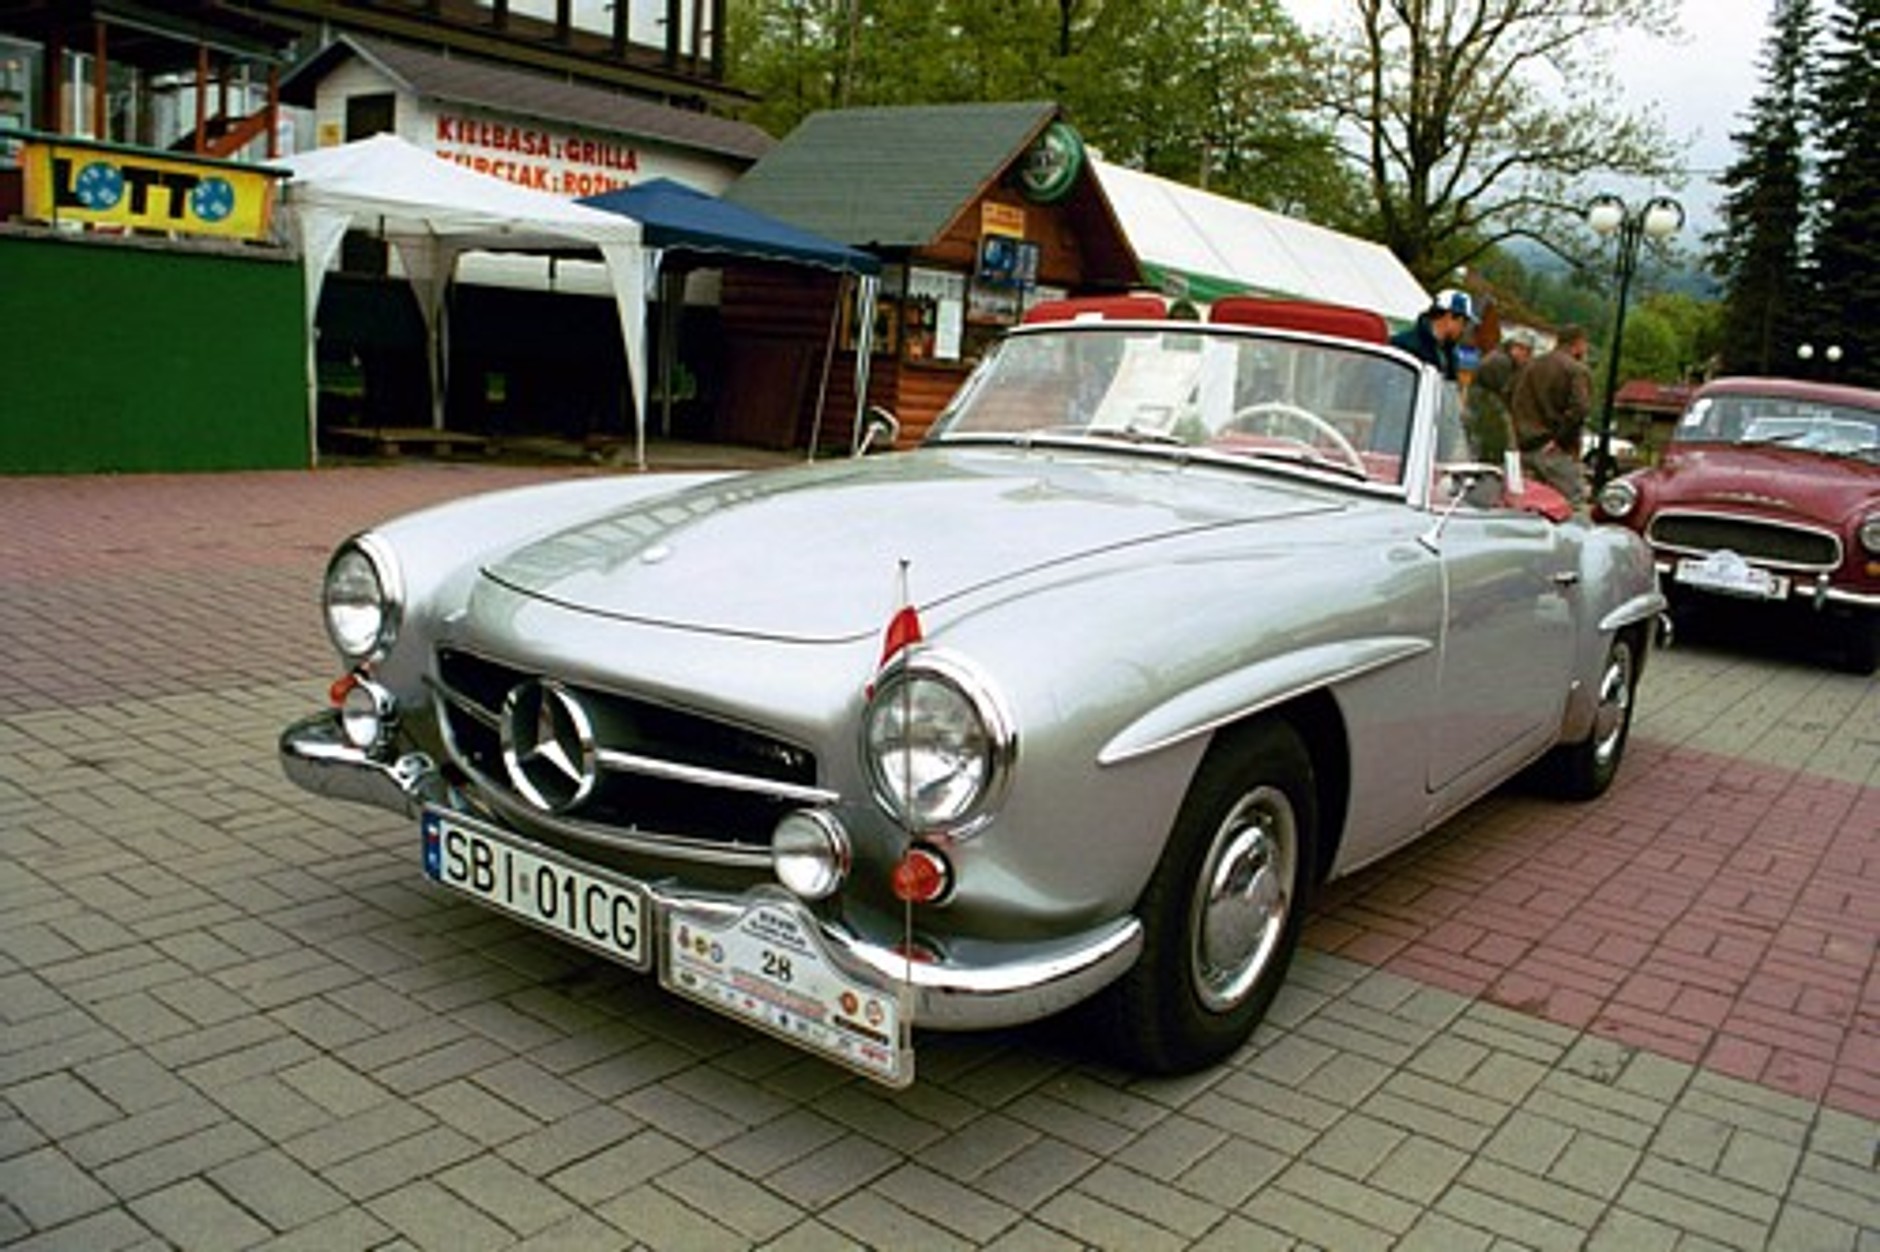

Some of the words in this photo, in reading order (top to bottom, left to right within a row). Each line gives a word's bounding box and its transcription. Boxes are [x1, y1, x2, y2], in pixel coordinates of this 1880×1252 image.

[565, 137, 637, 172] GRILLA
[53, 157, 234, 222] LOTTO
[446, 830, 513, 903] SBI
[762, 951, 792, 982] 28
